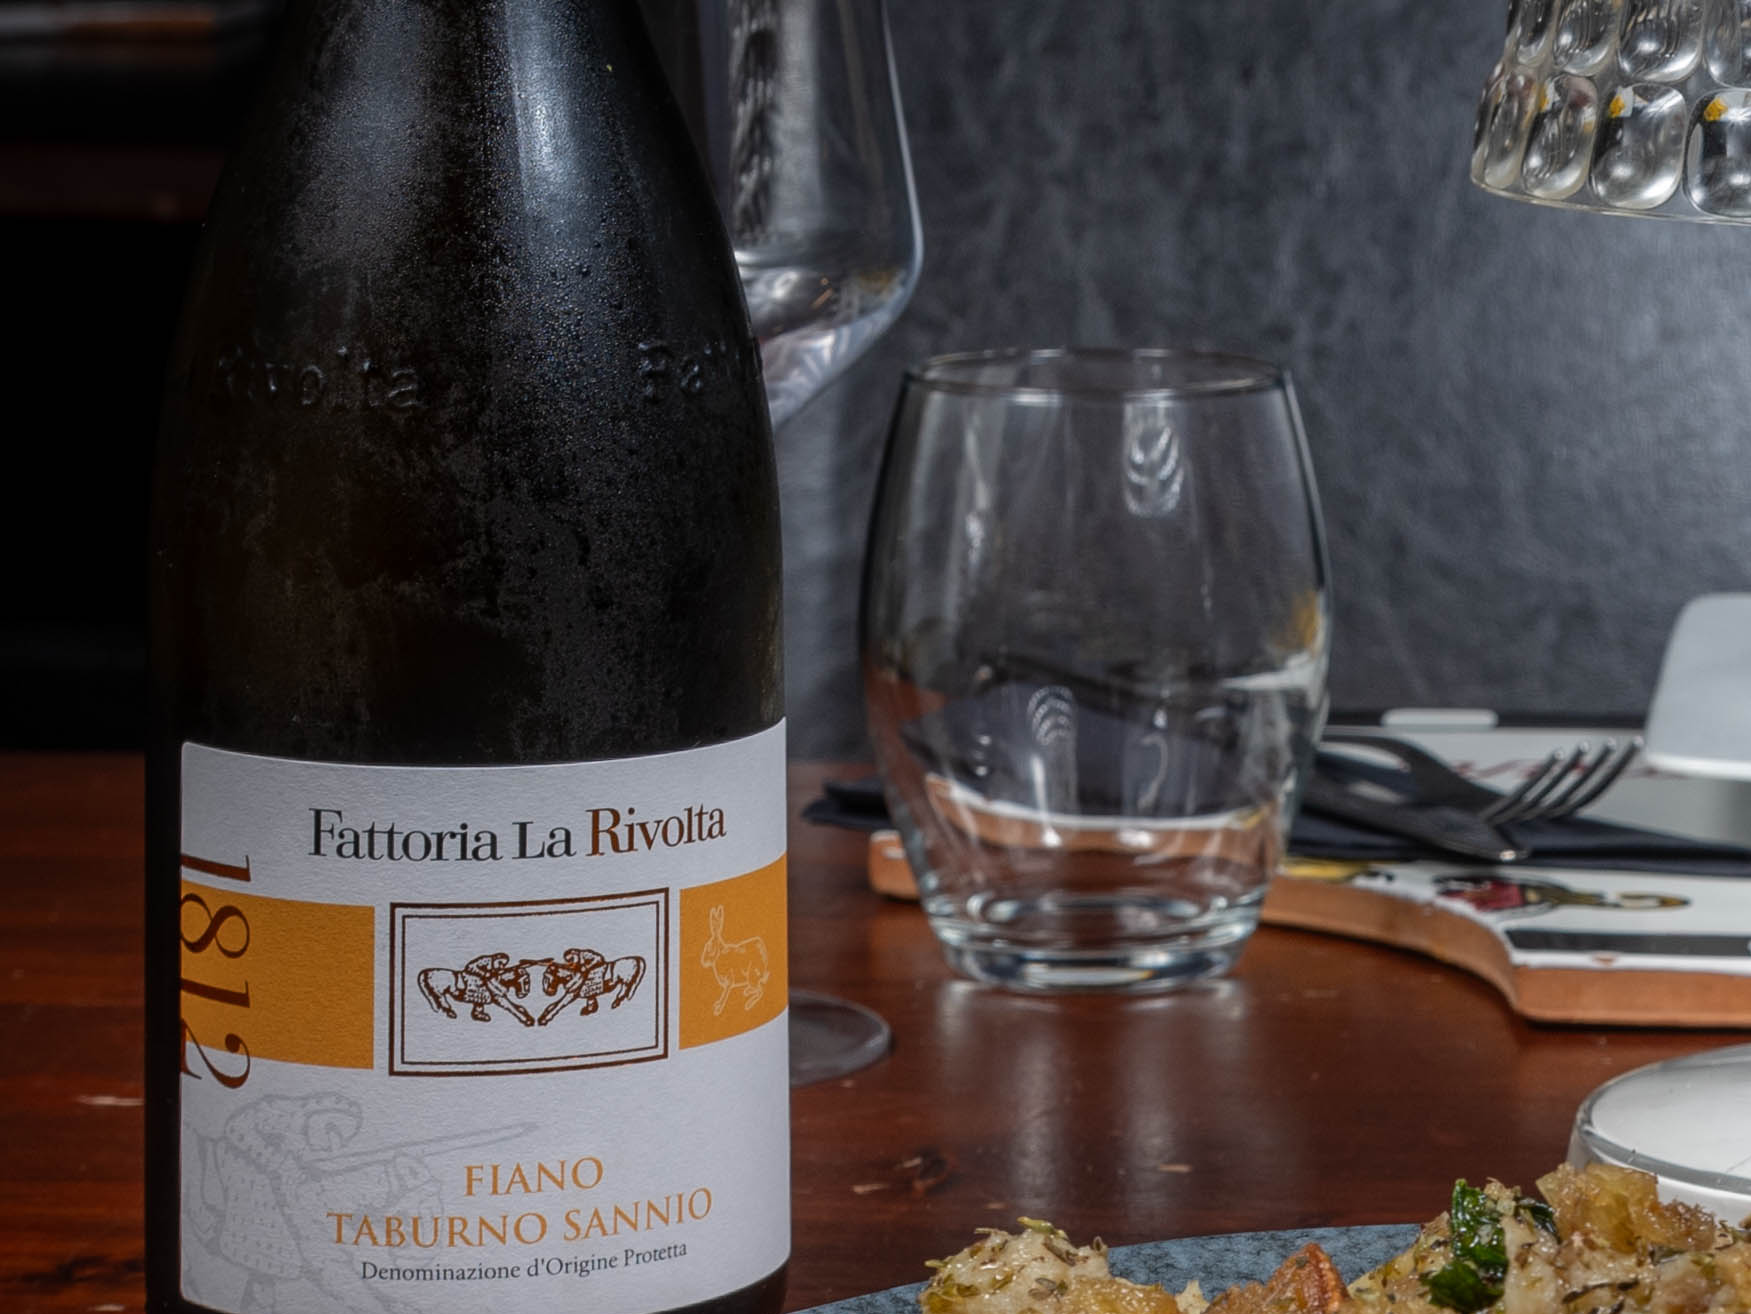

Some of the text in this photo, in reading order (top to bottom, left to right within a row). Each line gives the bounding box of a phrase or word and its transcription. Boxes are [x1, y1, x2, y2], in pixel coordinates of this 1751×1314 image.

[307, 802, 727, 862] Fattoria La Rivolta
[181, 852, 252, 1089] 1812
[463, 1156, 605, 1198] FIANO
[326, 1187, 713, 1249] TABURNO SANNIO
[360, 1240, 688, 1282] Denominazione d'Origine Protetta
